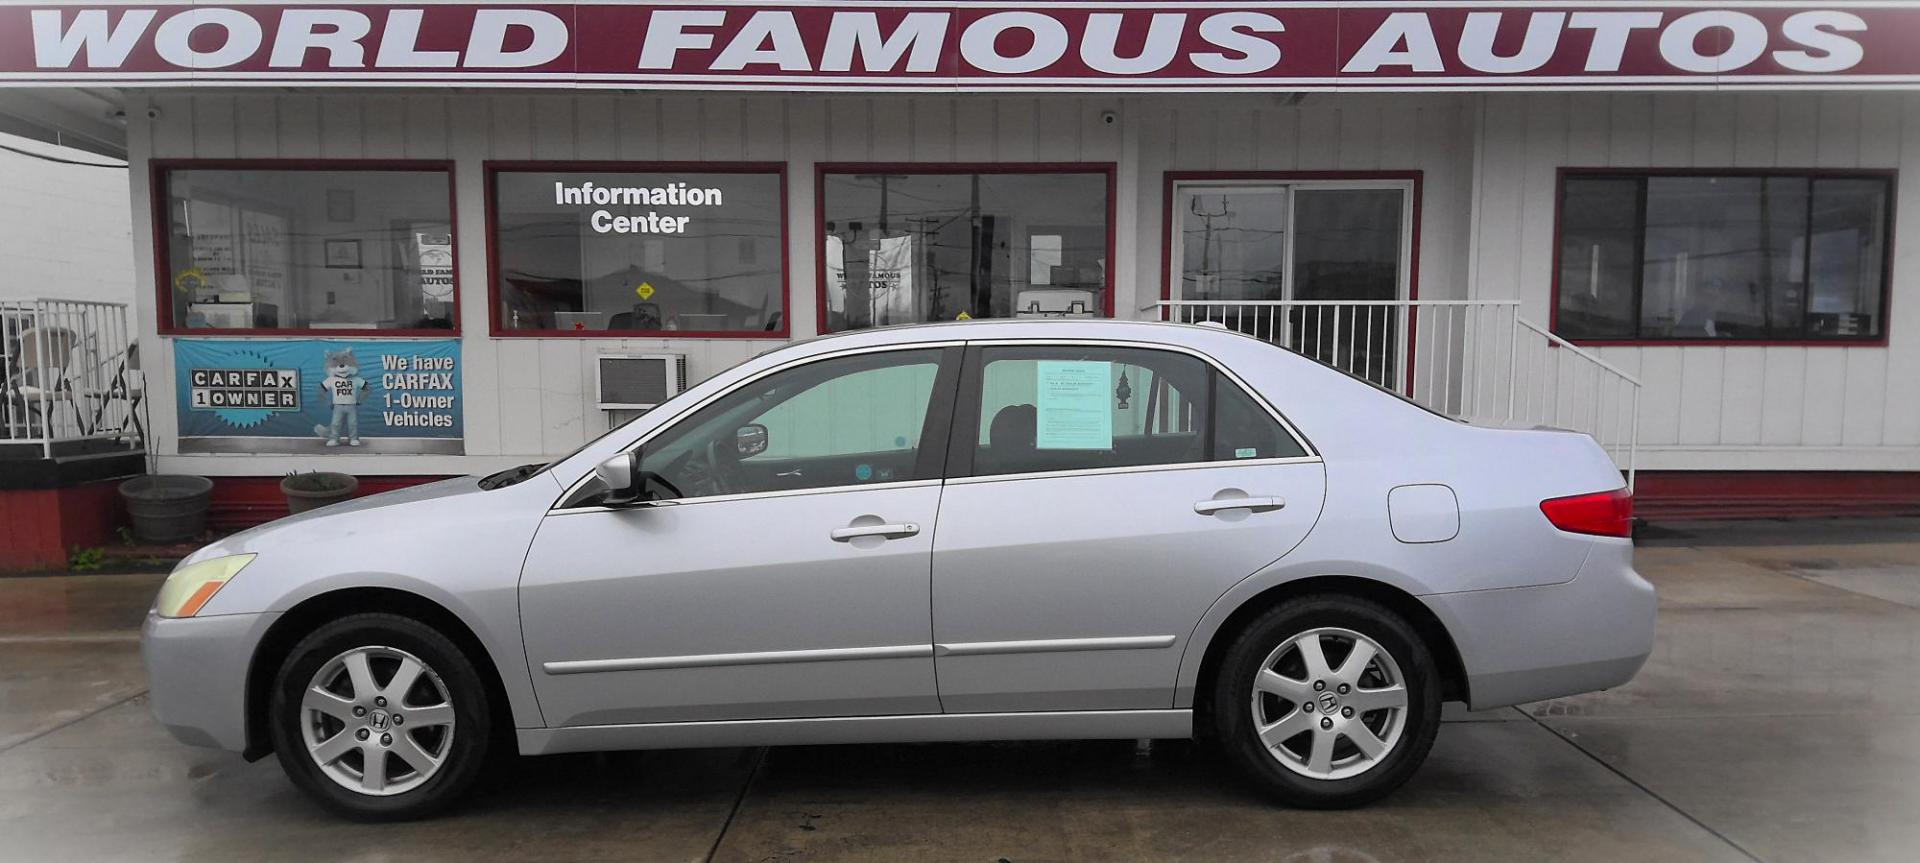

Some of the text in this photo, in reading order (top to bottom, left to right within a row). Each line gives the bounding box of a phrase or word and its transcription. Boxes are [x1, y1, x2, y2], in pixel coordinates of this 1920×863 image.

[31, 9, 1868, 75] WORLD FAMOUS AUTOS
[555, 181, 723, 206] Information
[590, 209, 690, 234] Center
[382, 354, 454, 370] We have
[194, 372, 293, 388] CARFAX
[382, 373, 454, 390] CARFAX
[383, 393, 455, 408] 1-Owner
[383, 411, 454, 427] Vehicles
